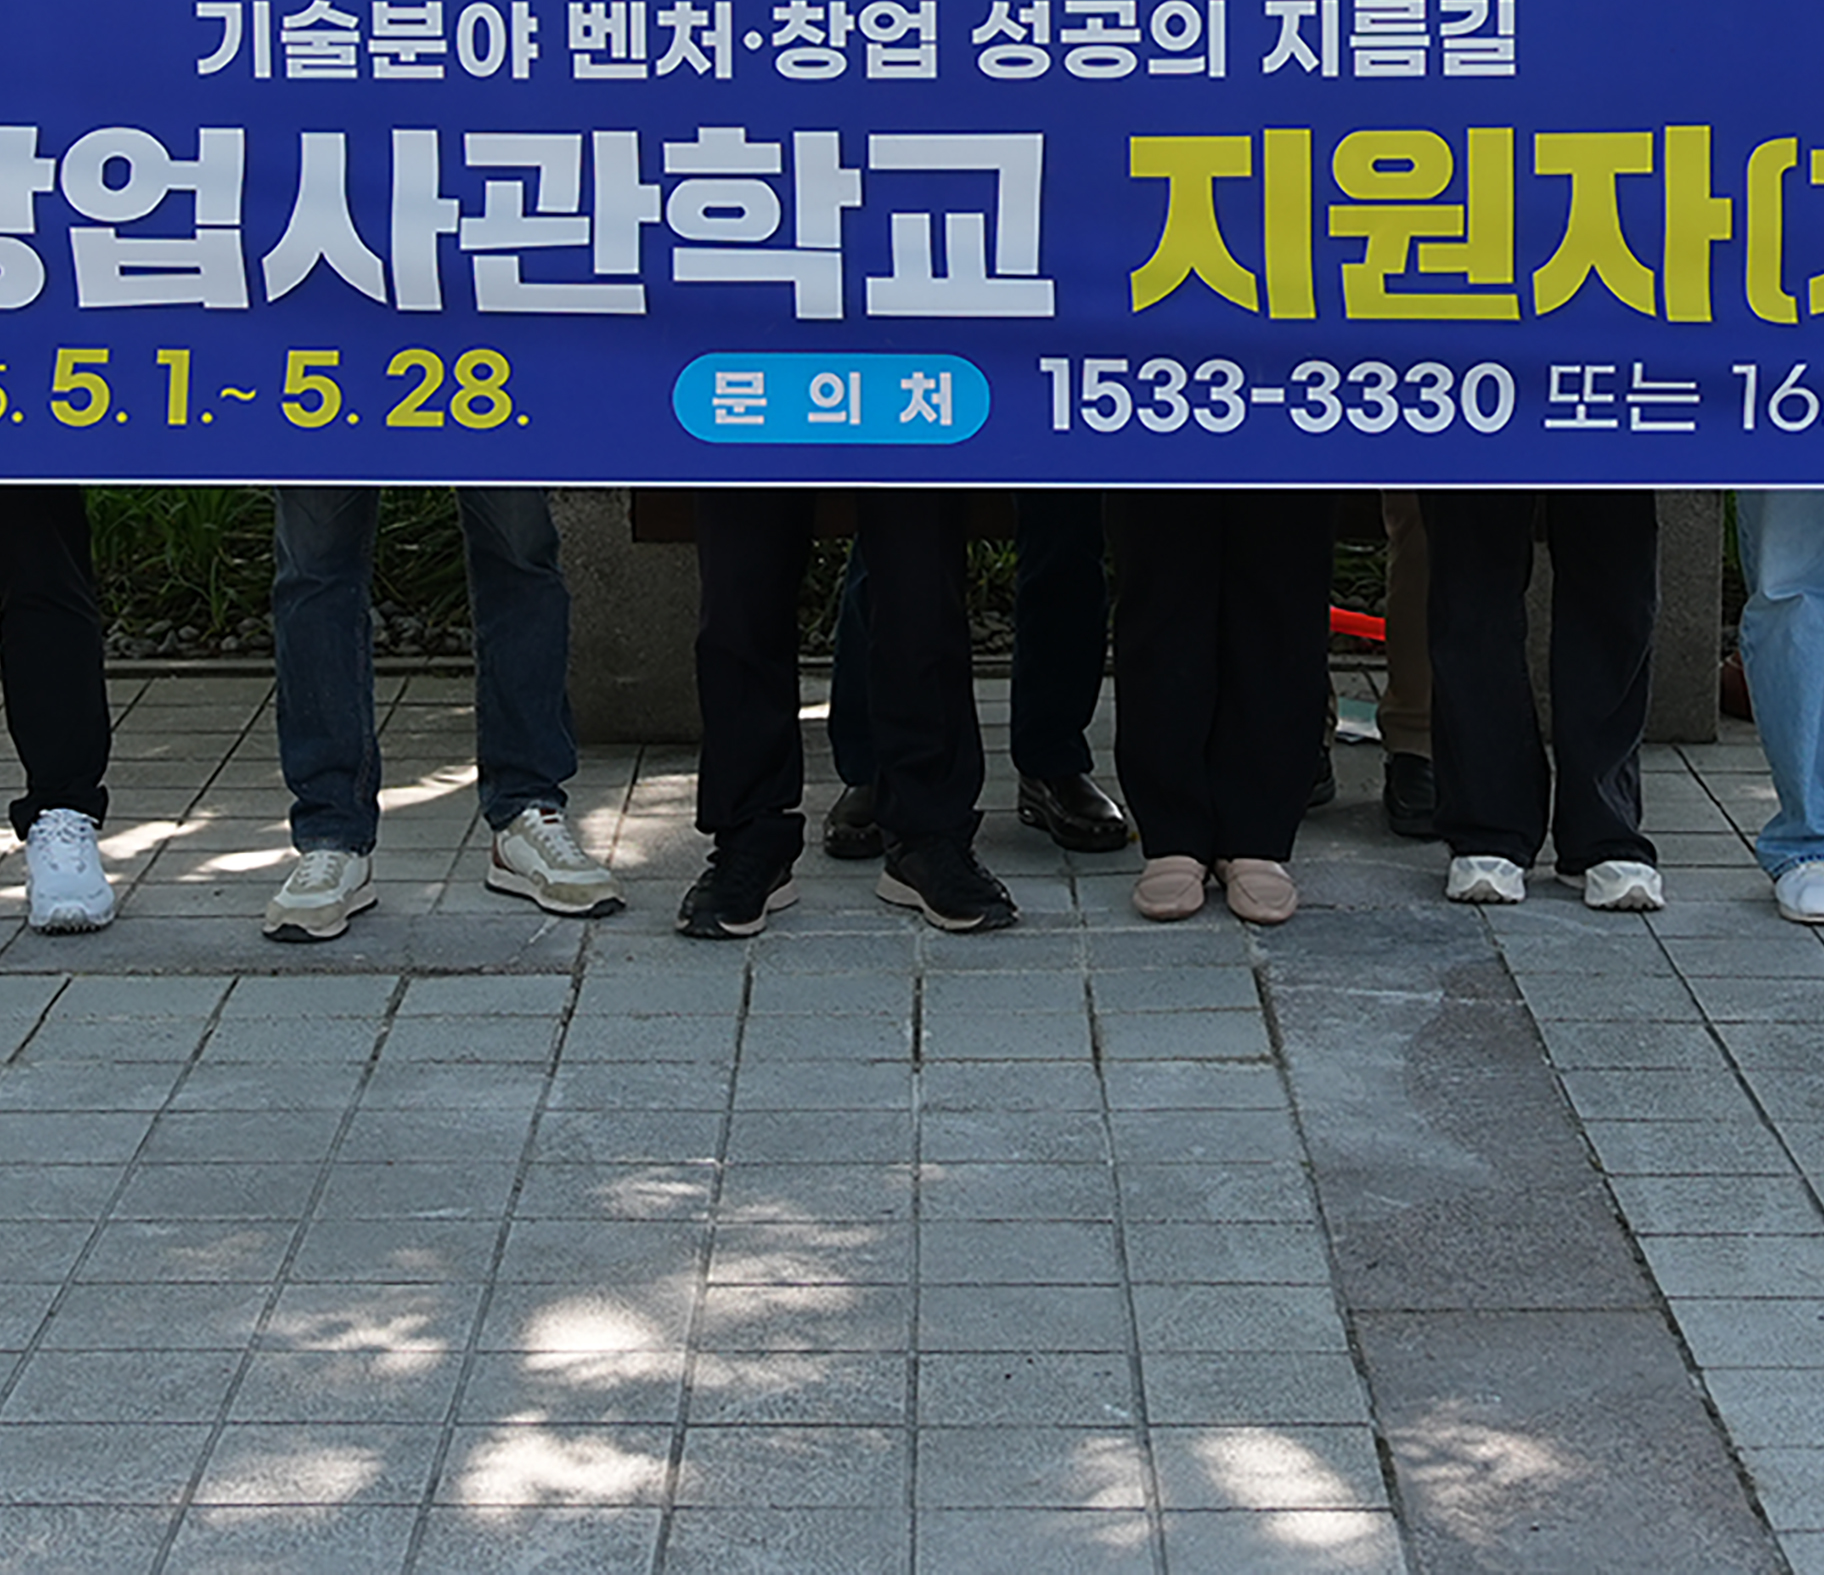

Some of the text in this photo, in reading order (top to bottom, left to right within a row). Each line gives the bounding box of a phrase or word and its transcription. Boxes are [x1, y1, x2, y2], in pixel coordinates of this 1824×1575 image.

[197, 0, 538, 79] 기술분야
[972, 0, 1225, 78] 성공의
[1040, 358, 1514, 433] 1533-3330
[1545, 363, 1700, 430] 또는
